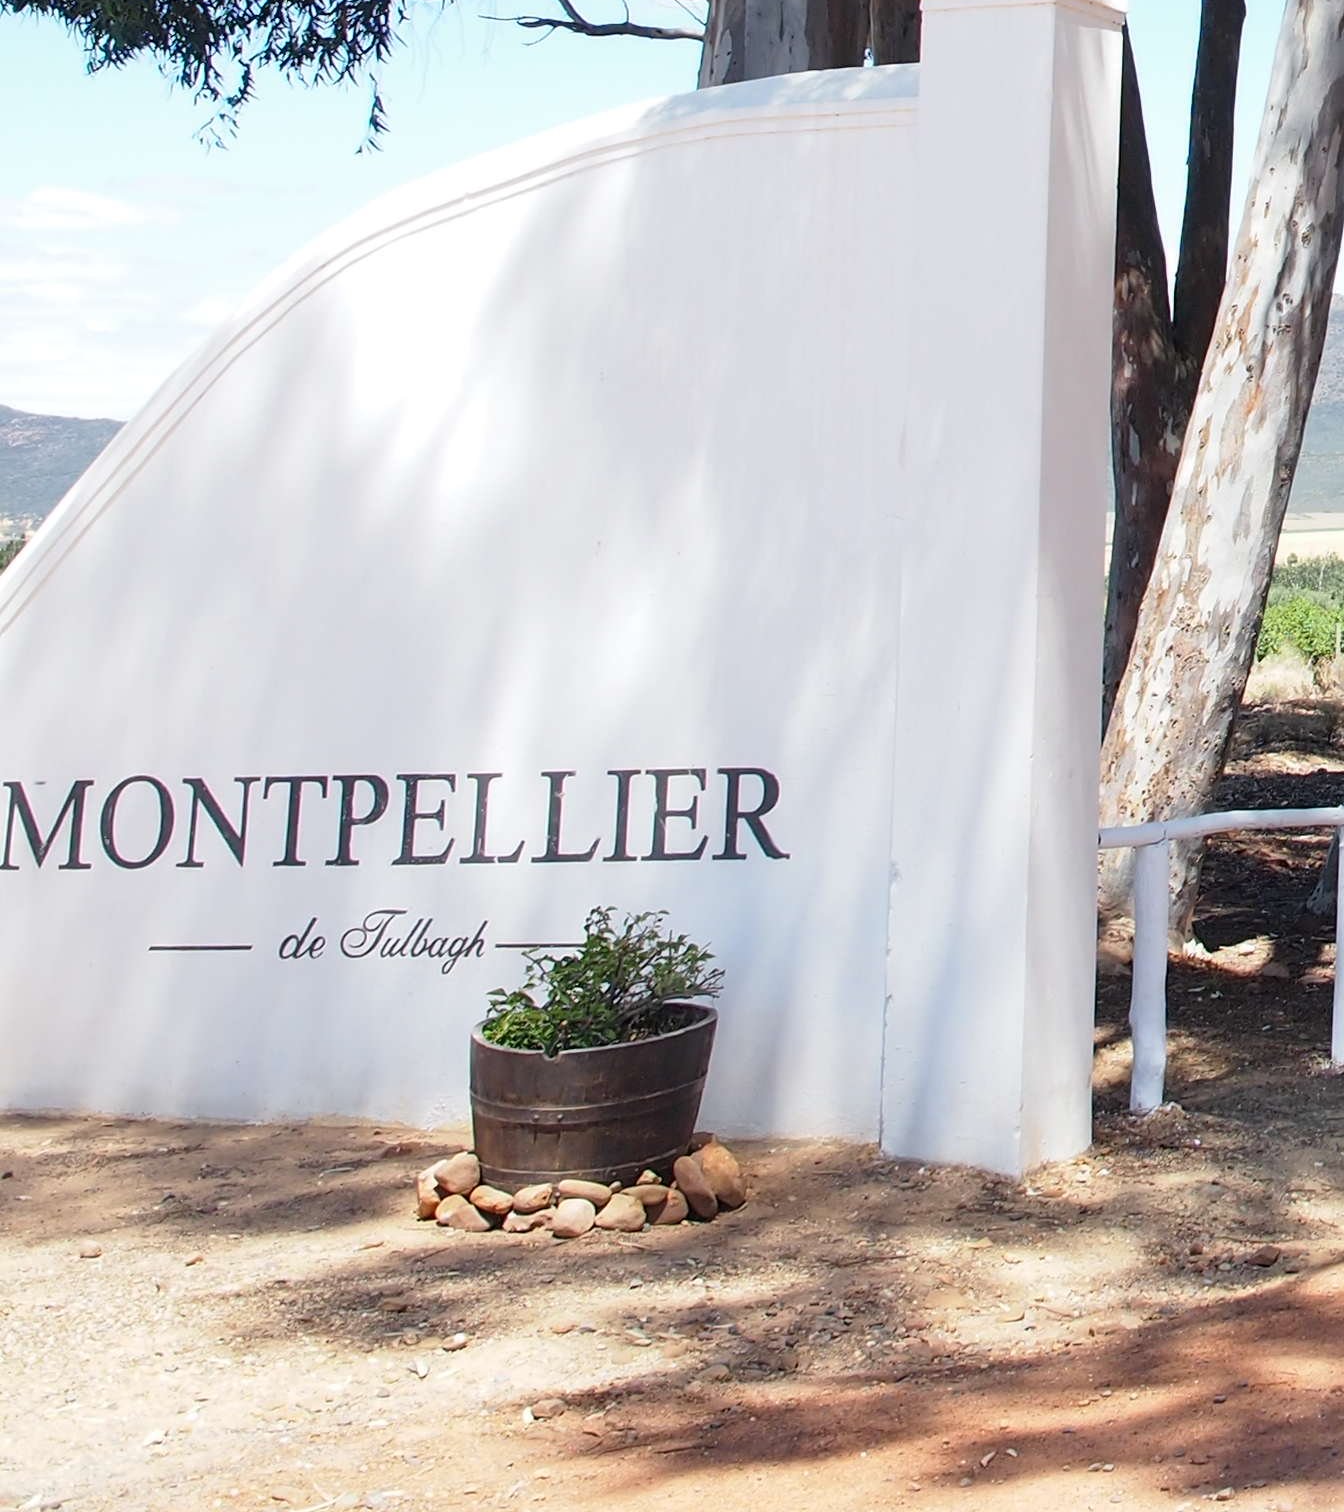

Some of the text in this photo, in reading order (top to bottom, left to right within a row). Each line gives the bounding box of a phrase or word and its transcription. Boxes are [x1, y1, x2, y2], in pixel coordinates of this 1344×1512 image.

[0, 767, 790, 870] MONTPELLIER
[278, 909, 489, 975] de Tulbagh
